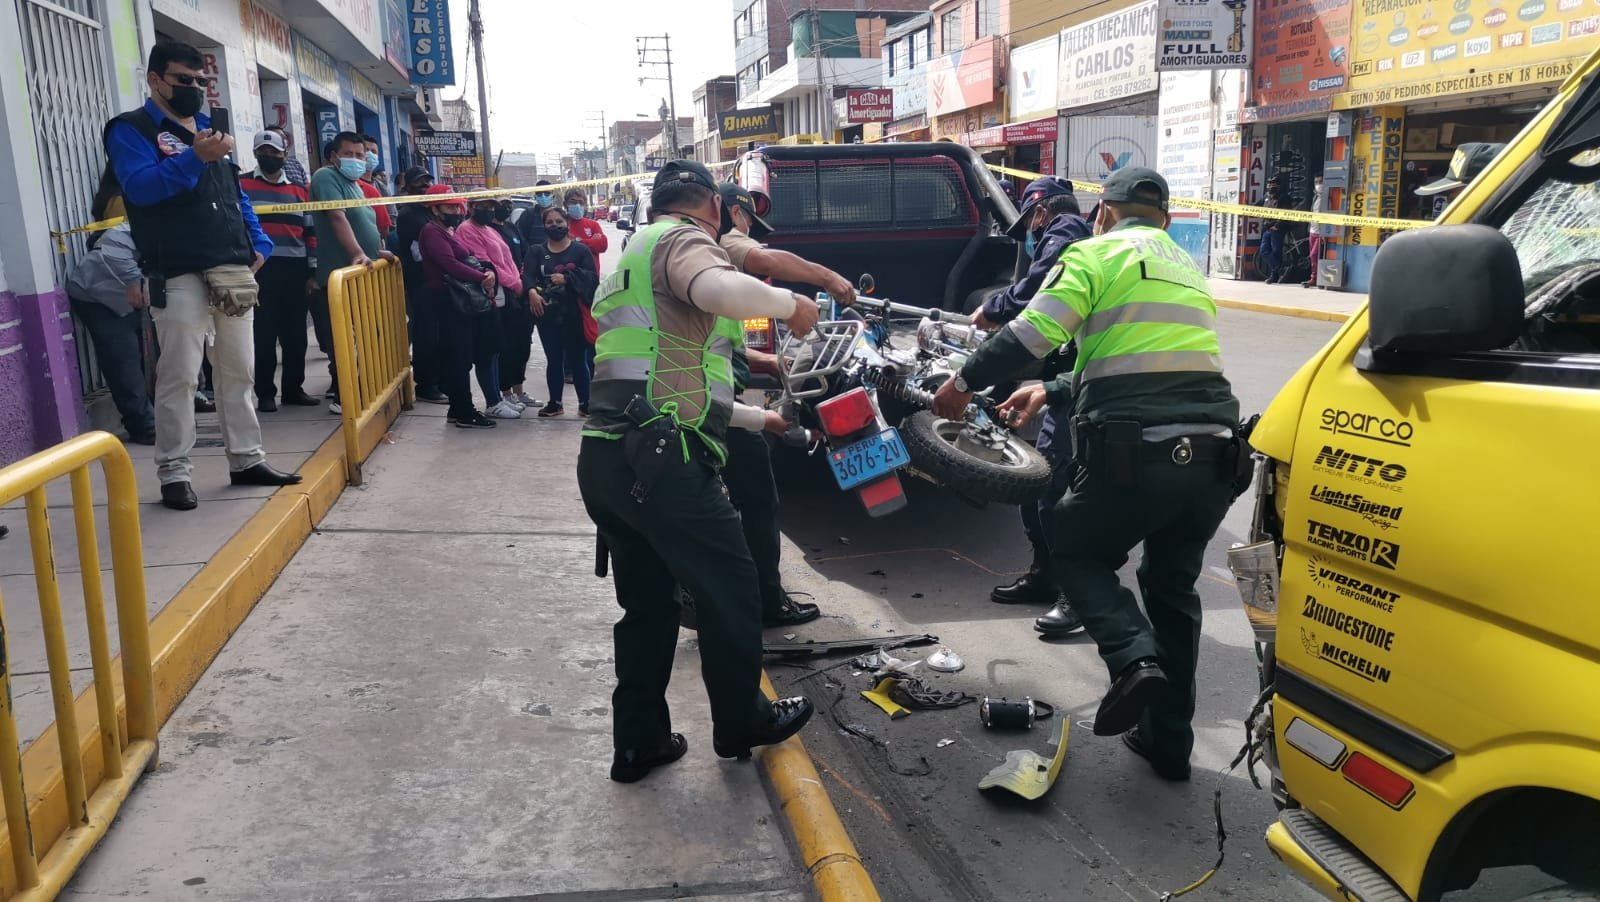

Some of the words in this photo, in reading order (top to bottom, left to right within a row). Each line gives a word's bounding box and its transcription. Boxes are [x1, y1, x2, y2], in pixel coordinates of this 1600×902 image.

[1364, 0, 1422, 16] REPARA
[436, 0, 448, 76] CCESORIOS
[1063, 25, 1094, 61] TALLER
[1097, 4, 1158, 45] MECANICO
[1164, 31, 1210, 40] MANDO
[1164, 44, 1223, 55] FULL
[1075, 43, 1134, 79] CARLOS
[1160, 55, 1247, 66] AMORTIGUADORES
[1318, 77, 1343, 89] NISSAN
[1394, 83, 1432, 99] PEDIDOS
[1435, 72, 1493, 93] ESPECIALES
[1498, 72, 1513, 84] EN
[1519, 68, 1531, 82] 18
[1537, 63, 1573, 80] HORAS
[1246, 140, 1263, 235] PALIR
[1321, 408, 1414, 441] sparco
[834, 439, 901, 481] 3676-2V
[1313, 445, 1407, 482] NITTO
[1345, 474, 1404, 493] PERFORMANCE
[1309, 484, 1403, 521] LightSpeed
[1307, 519, 1370, 553] TENZO
[1307, 535, 1335, 551] RACING
[1336, 544, 1368, 561] SPORTS
[1319, 567, 1401, 603] VIBRANT
[1335, 585, 1395, 613] PERFORMANCE
[1302, 594, 1396, 652] BRIDGESTONE
[1321, 641, 1392, 684] MICHELIN
